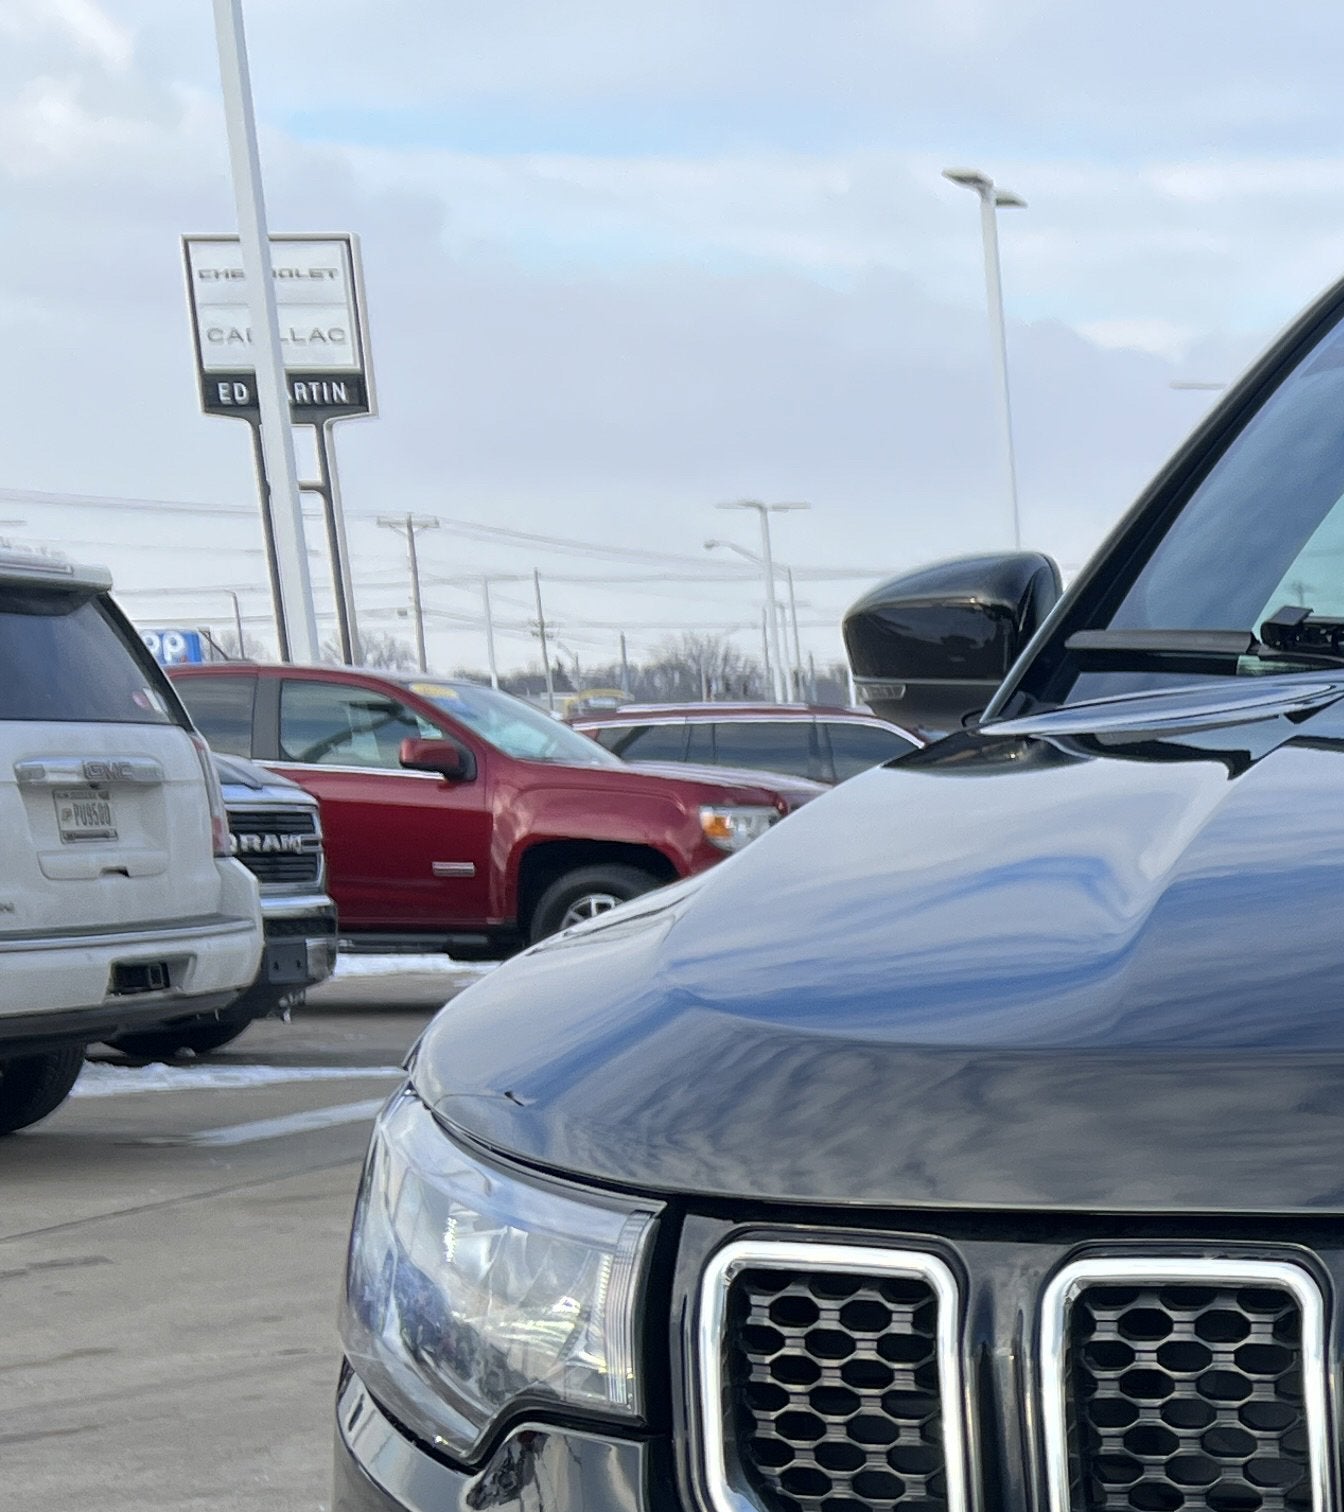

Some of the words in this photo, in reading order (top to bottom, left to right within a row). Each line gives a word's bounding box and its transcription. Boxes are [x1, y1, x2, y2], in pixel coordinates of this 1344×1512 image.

[198, 267, 338, 280] CHEOLET
[206, 327, 346, 343] CALAC
[217, 382, 248, 404] ED
[287, 382, 348, 403] RTIN
[83, 761, 134, 781] GMC
[239, 833, 303, 855] RAM
